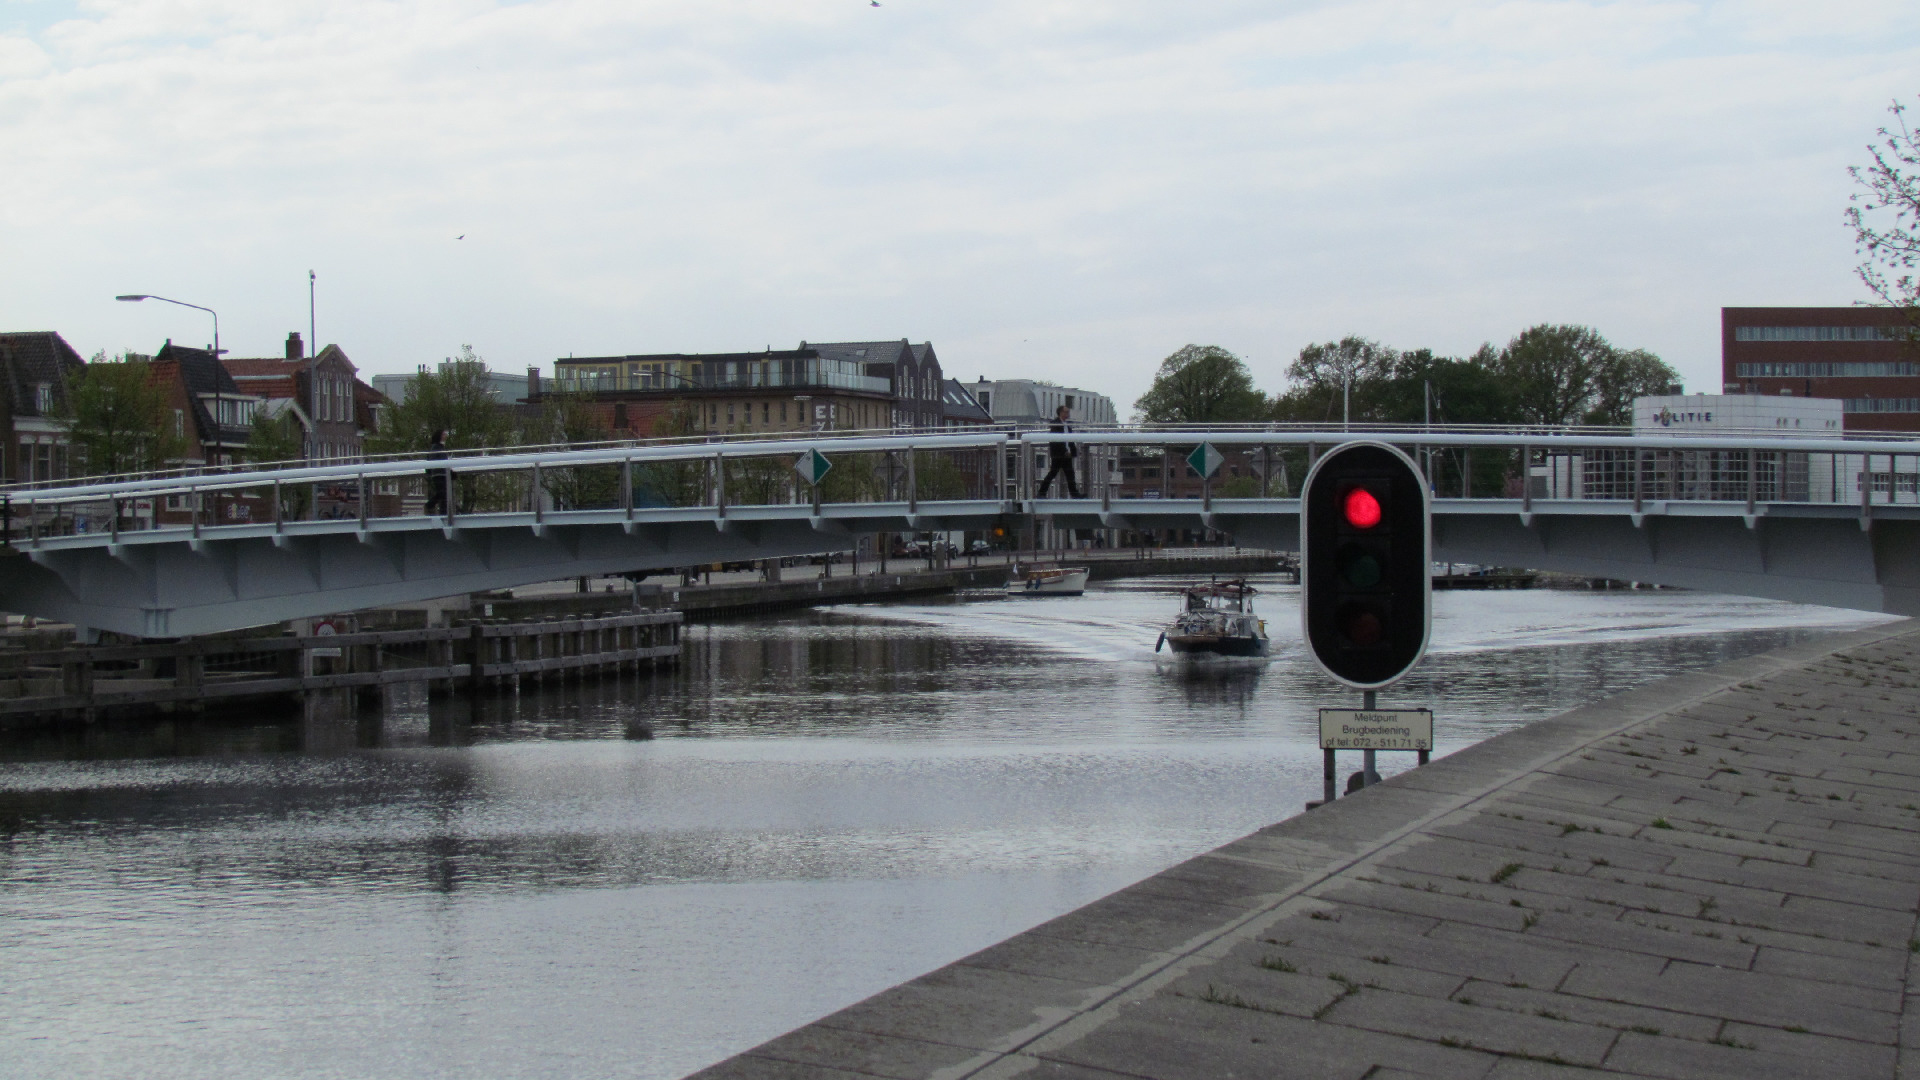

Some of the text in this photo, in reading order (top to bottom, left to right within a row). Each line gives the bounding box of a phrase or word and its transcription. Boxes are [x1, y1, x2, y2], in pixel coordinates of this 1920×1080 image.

[1354, 713, 1398, 723] Meldpunt
[1342, 724, 1410, 736] Brugbediening
[1353, 738, 1371, 747] 072
[1380, 739, 1397, 747] 511
[1401, 739, 1411, 748] 71
